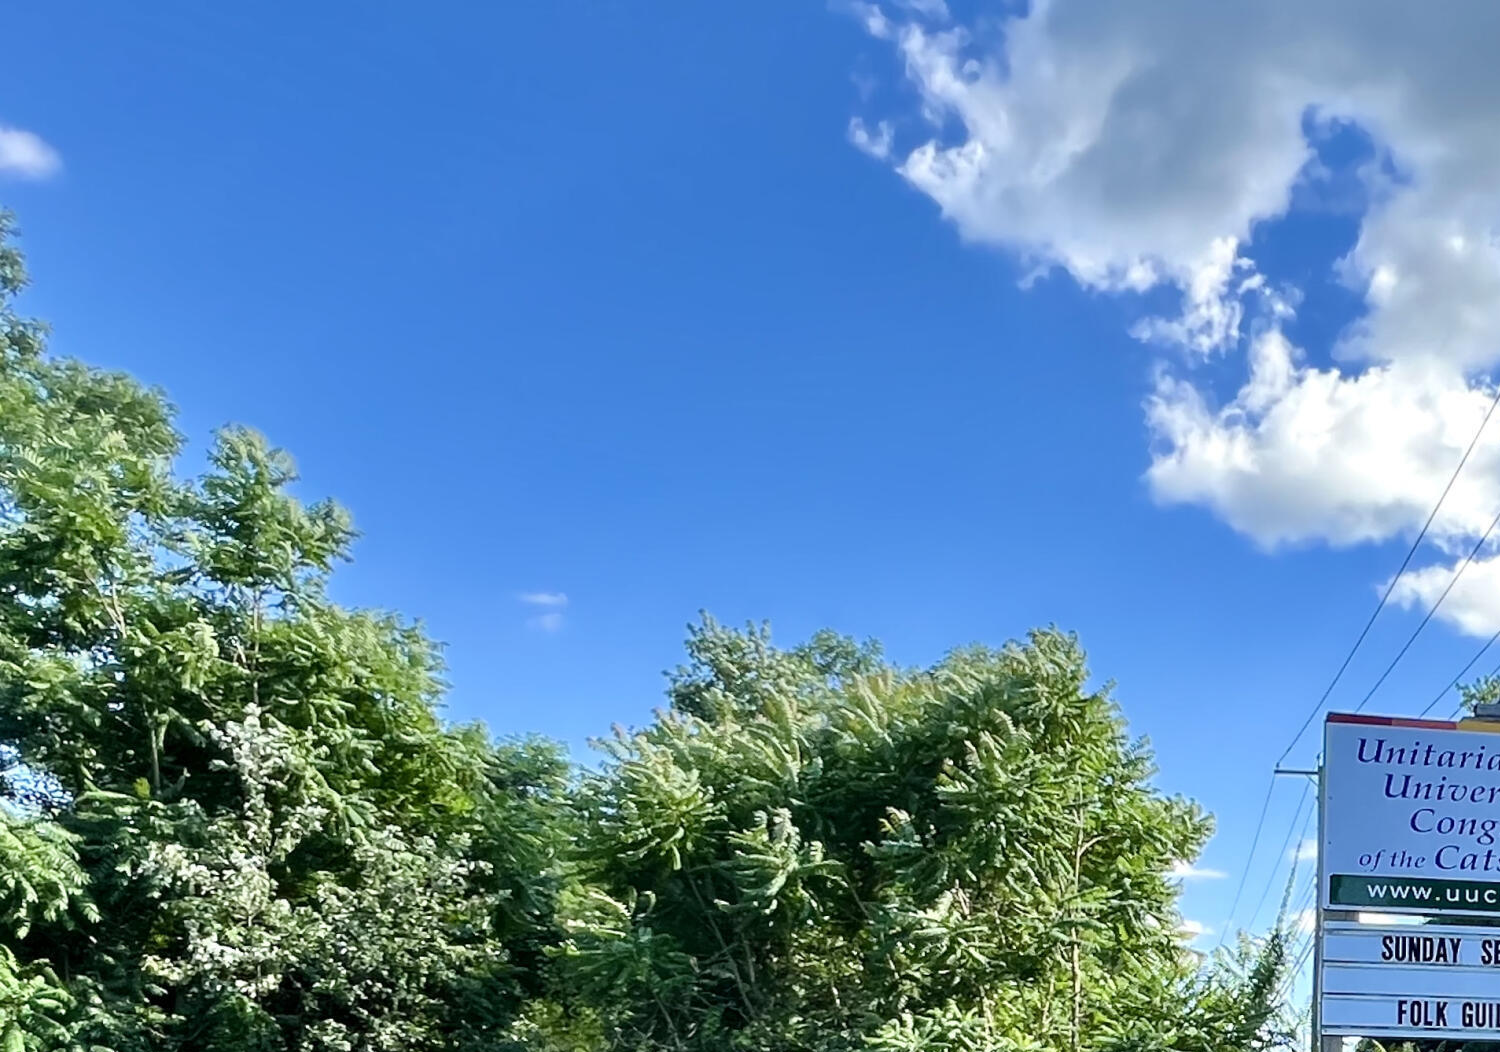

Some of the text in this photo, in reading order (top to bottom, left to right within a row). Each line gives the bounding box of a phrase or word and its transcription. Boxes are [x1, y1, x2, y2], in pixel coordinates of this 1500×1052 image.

[1358, 849, 1385, 872] of
[1389, 850, 1426, 869] the
[1381, 935, 1462, 963] SUNDAY
[1397, 999, 1448, 1027] FOLK
